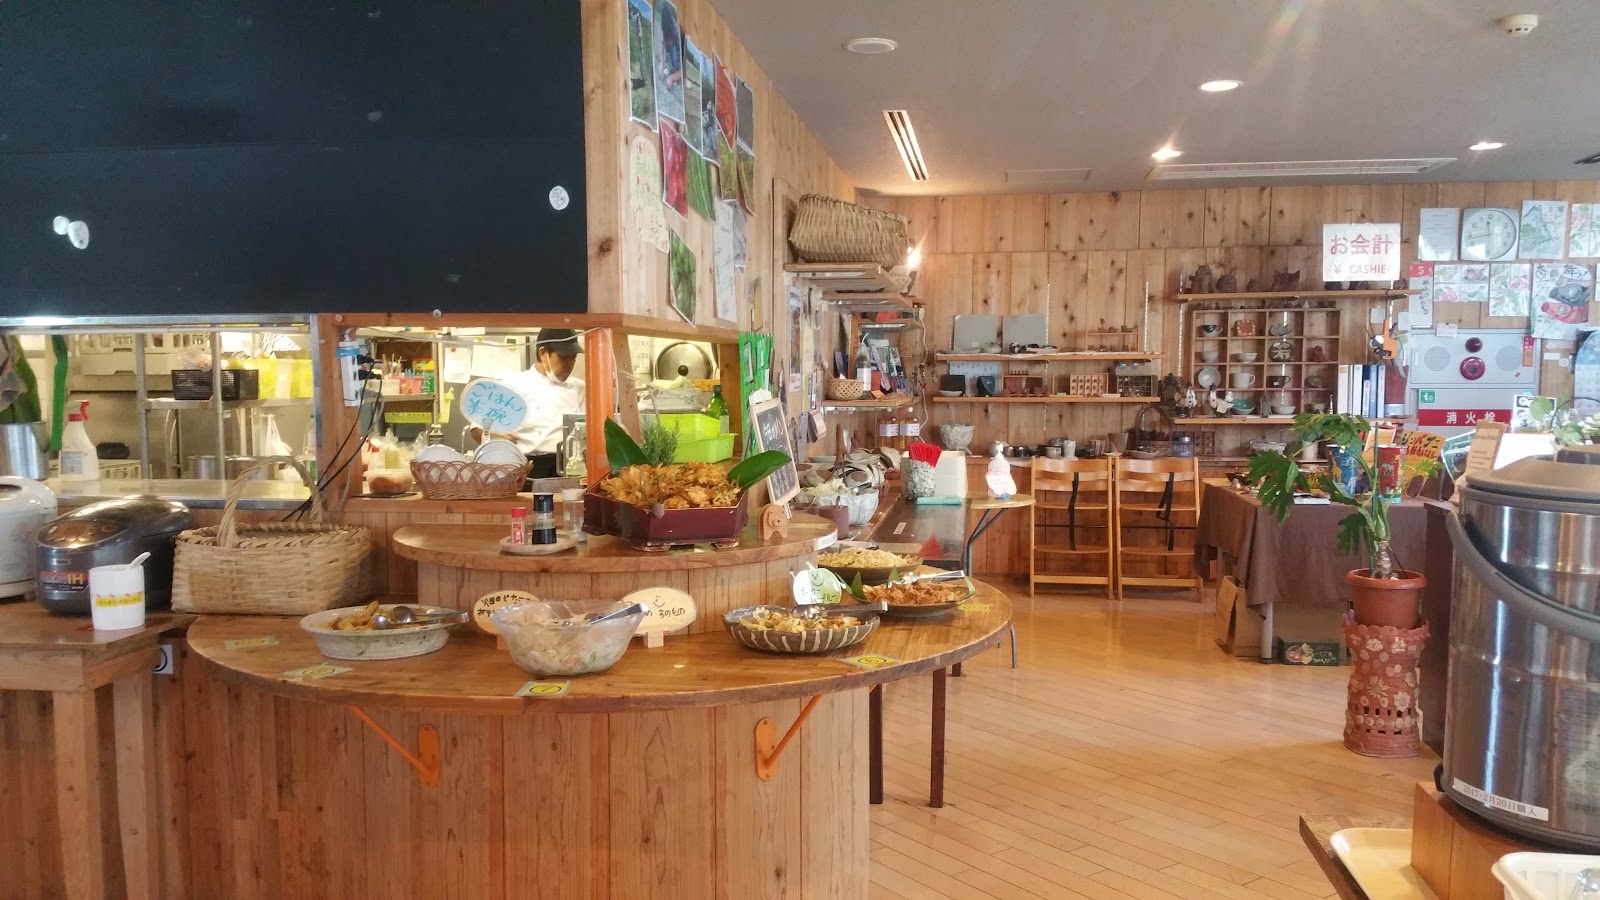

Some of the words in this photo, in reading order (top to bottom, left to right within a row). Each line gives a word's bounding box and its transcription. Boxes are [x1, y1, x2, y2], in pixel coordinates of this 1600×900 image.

[1330, 233, 1392, 255] お会計
[472, 382, 523, 411] ごはん
[68, 573, 84, 585] IH
